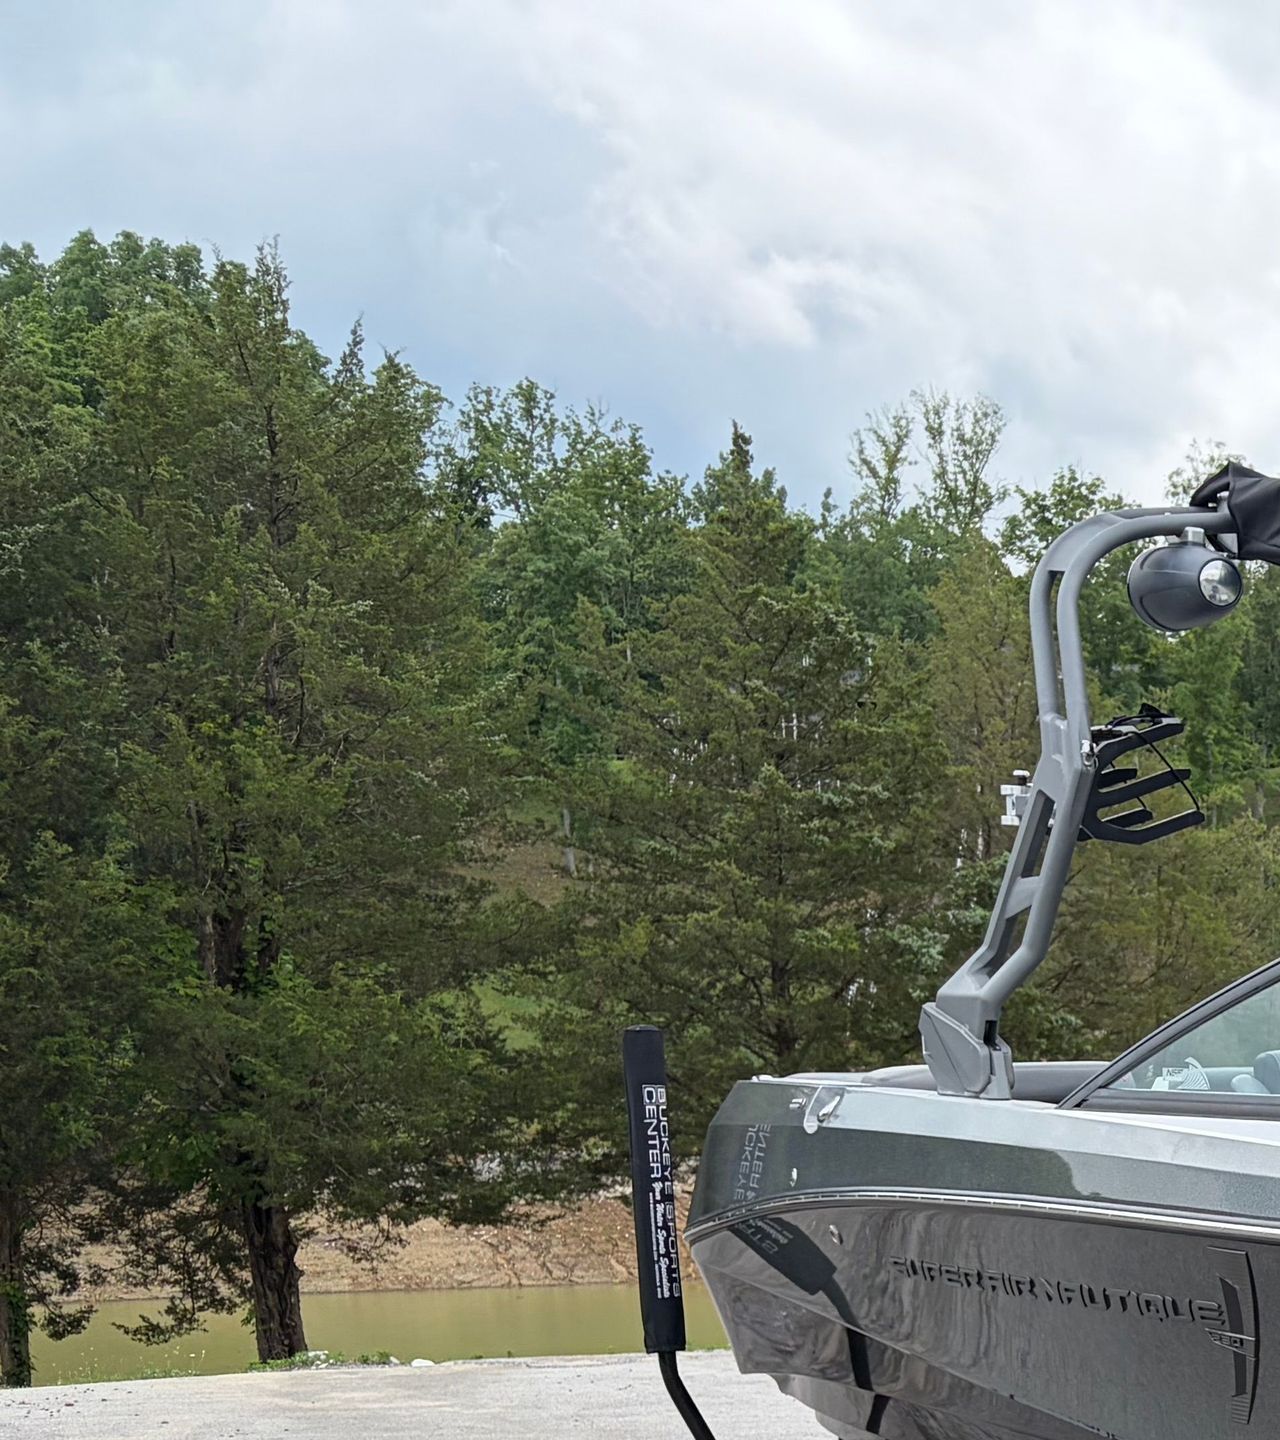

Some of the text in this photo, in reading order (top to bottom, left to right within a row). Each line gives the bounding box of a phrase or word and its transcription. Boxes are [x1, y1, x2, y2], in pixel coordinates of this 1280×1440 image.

[643, 1087, 662, 1178] CENTER
[652, 1181, 663, 1200] Your
[657, 1087, 681, 1298] BUCKEYE SPORTS
[656, 1202, 665, 1227] Water
[657, 1228, 667, 1253] Sports
[1039, 1277, 1226, 1326] NAUTIQUE
